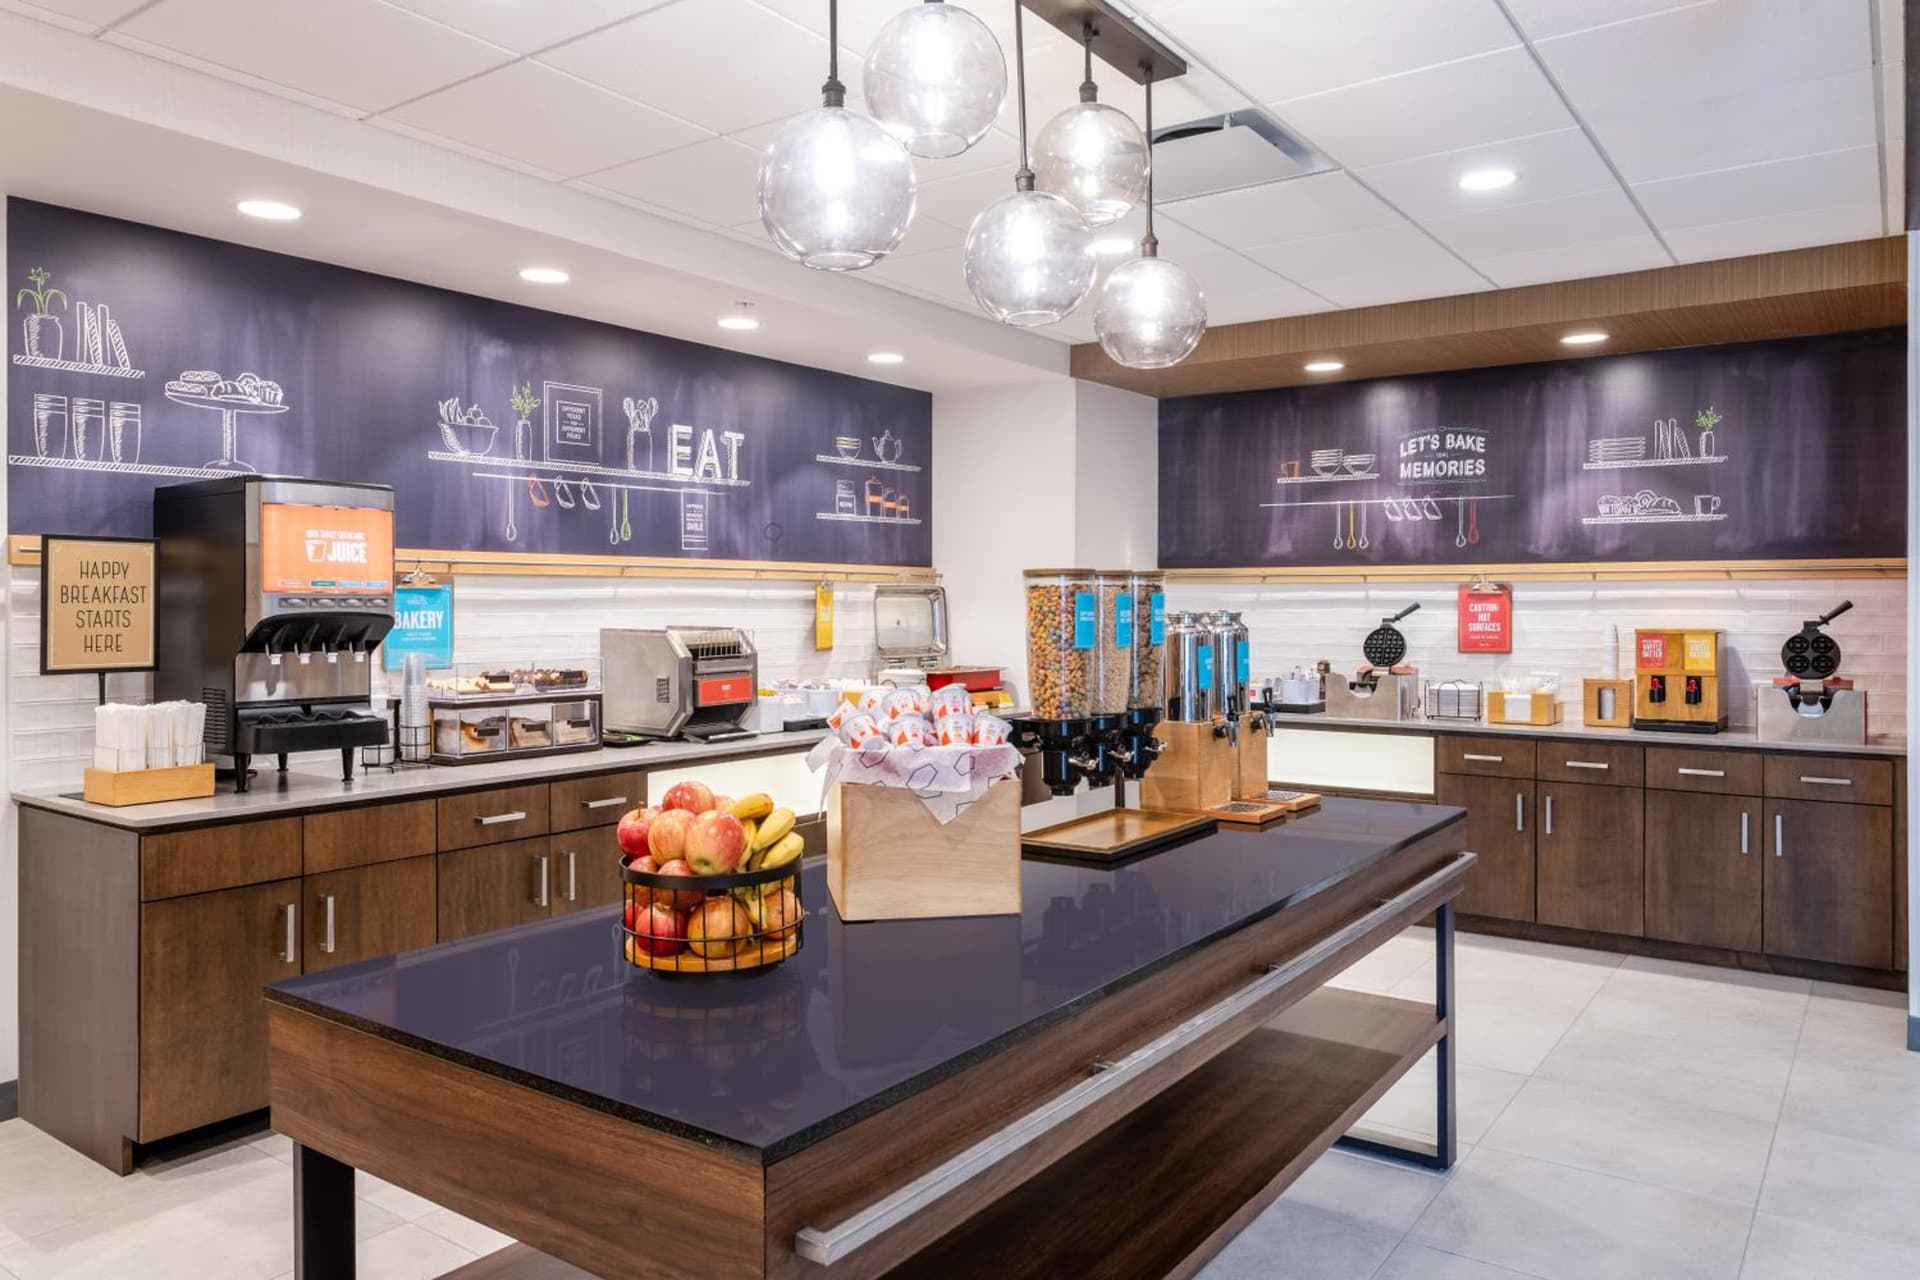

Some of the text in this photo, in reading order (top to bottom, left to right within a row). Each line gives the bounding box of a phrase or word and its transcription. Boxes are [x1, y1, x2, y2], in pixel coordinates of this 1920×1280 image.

[667, 423, 745, 482] EAT
[1399, 433, 1486, 458] LET'S BAKE
[1400, 459, 1486, 479] MEMORIES
[327, 541, 368, 564] JUICE
[79, 560, 130, 580] HAPPY
[60, 584, 149, 605] BREAKFAST
[75, 609, 132, 629] STARTS
[394, 610, 444, 630] BAKERY
[84, 633, 123, 654] HERE
